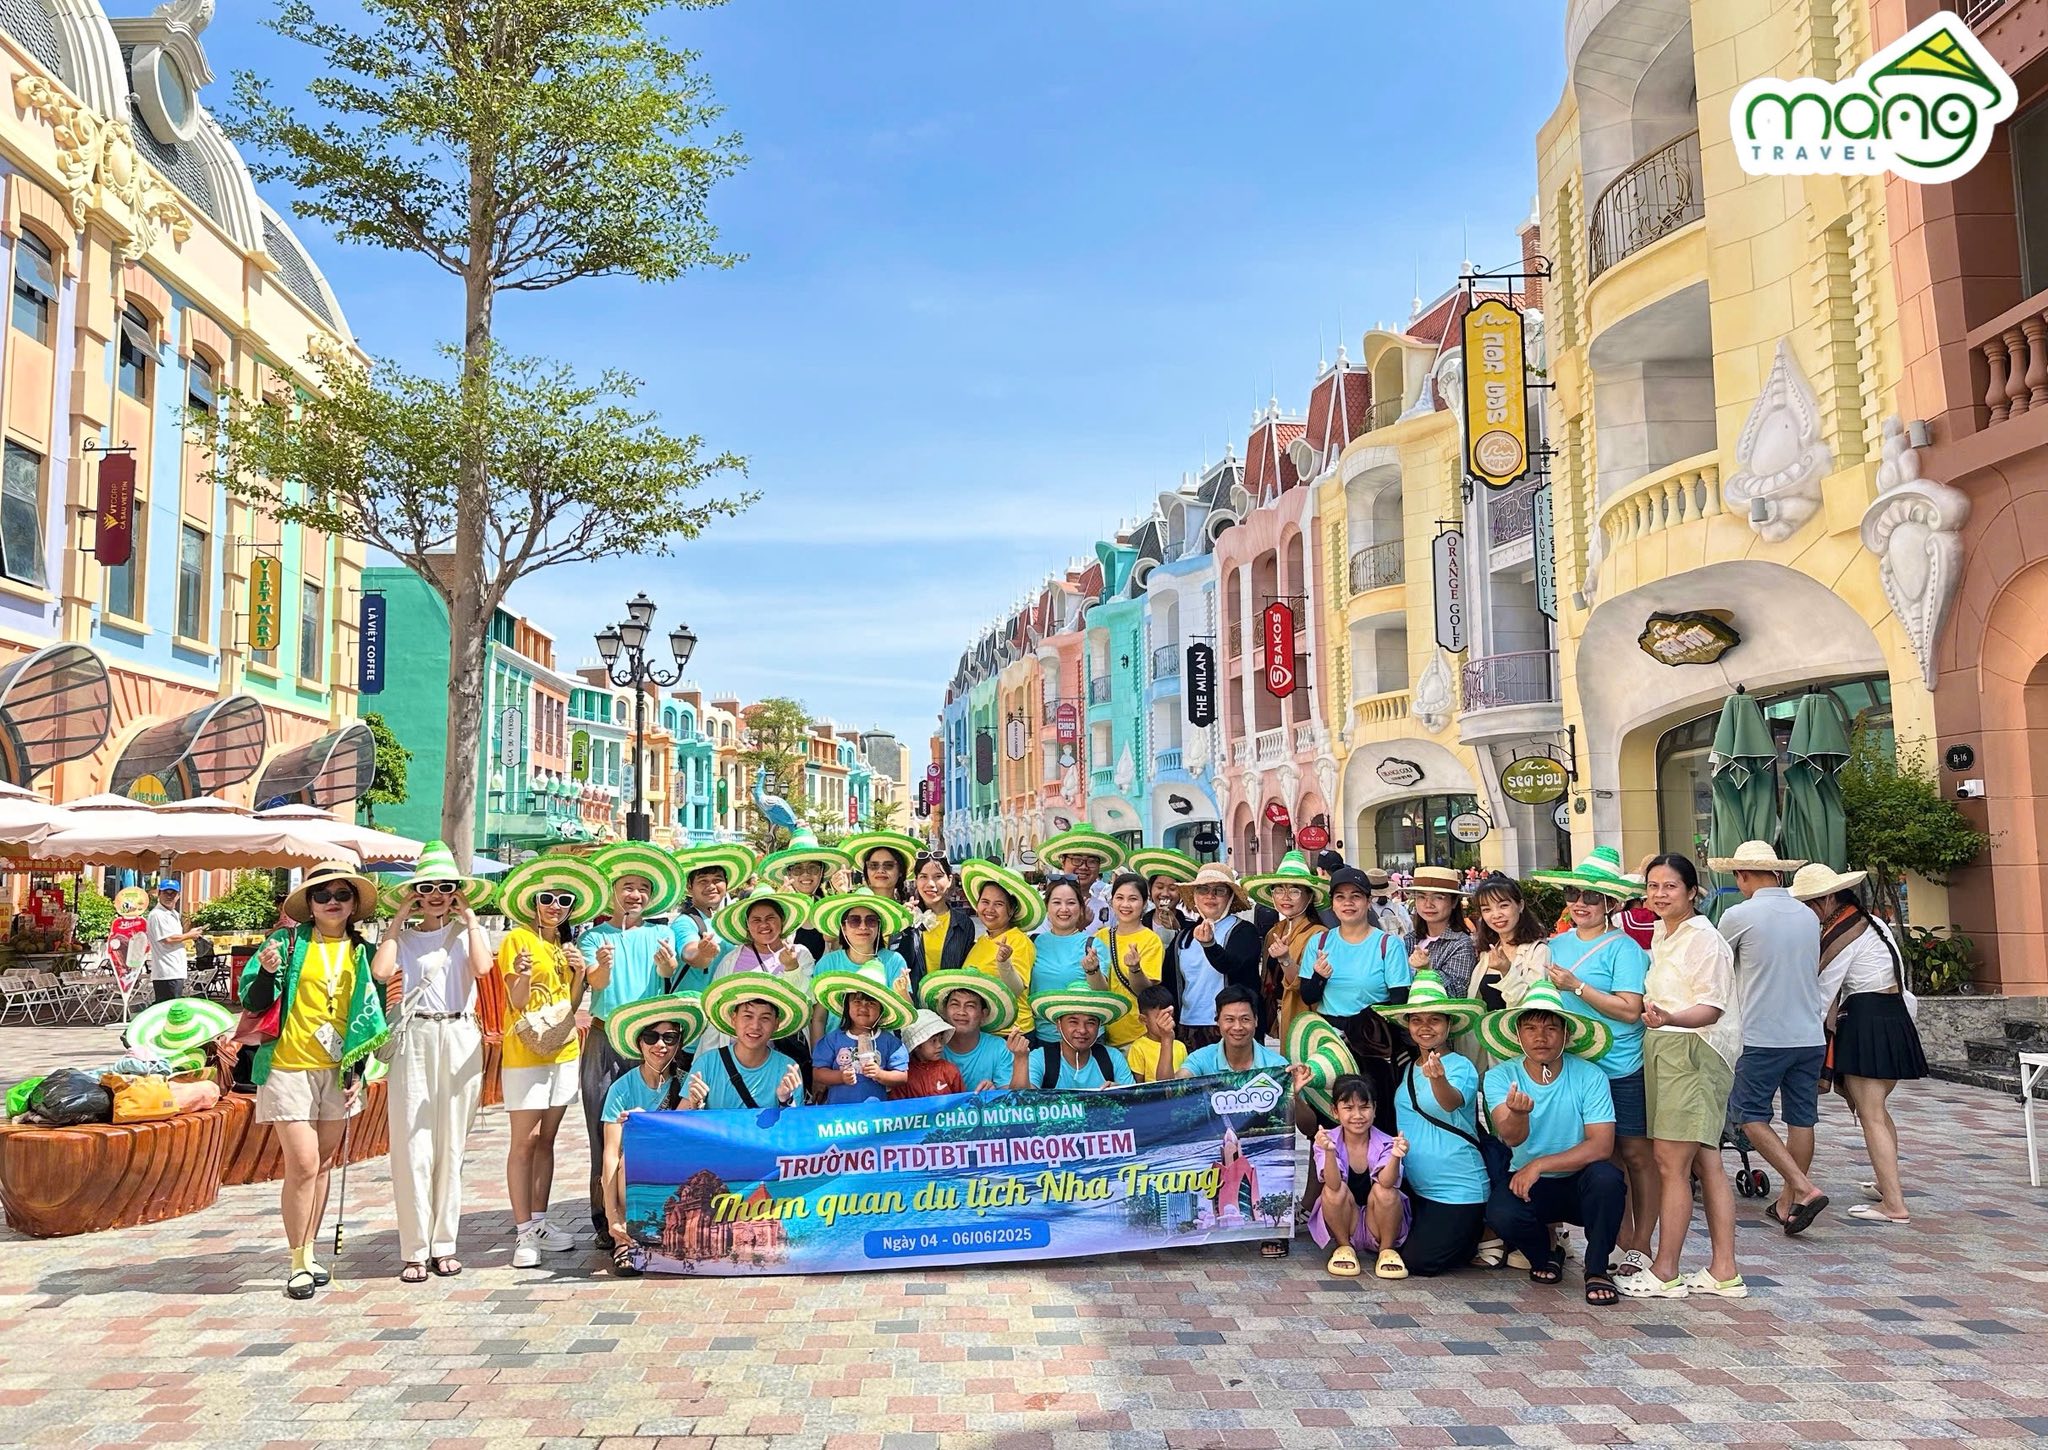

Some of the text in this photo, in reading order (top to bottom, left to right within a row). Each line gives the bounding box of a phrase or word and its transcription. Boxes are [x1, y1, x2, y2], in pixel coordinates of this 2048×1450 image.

[1537, 494, 1548, 611] ORANGE GOLF
[256, 559, 272, 647] VIET MART
[1447, 536, 1461, 647] ORANGE GOLF
[367, 645, 376, 681] COFFEE
[1273, 612, 1283, 665] SAKOS
[1195, 651, 1207, 718] THE MILAN
[1060, 730, 1073, 738] LATE
[817, 1100, 1084, 1138] MĂNG TRAVEL CHÀO MỪNG ĐOÀN
[779, 1132, 1133, 1179] TRƯỜNG PTDTBT TH NGỌK TEM
[710, 1164, 1225, 1228] Tham quan du lịch Nha Trang
[883, 1234, 916, 1252] Ngày
[920, 1233, 939, 1247] 04
[952, 1227, 1032, 1246] 06/06/2025
